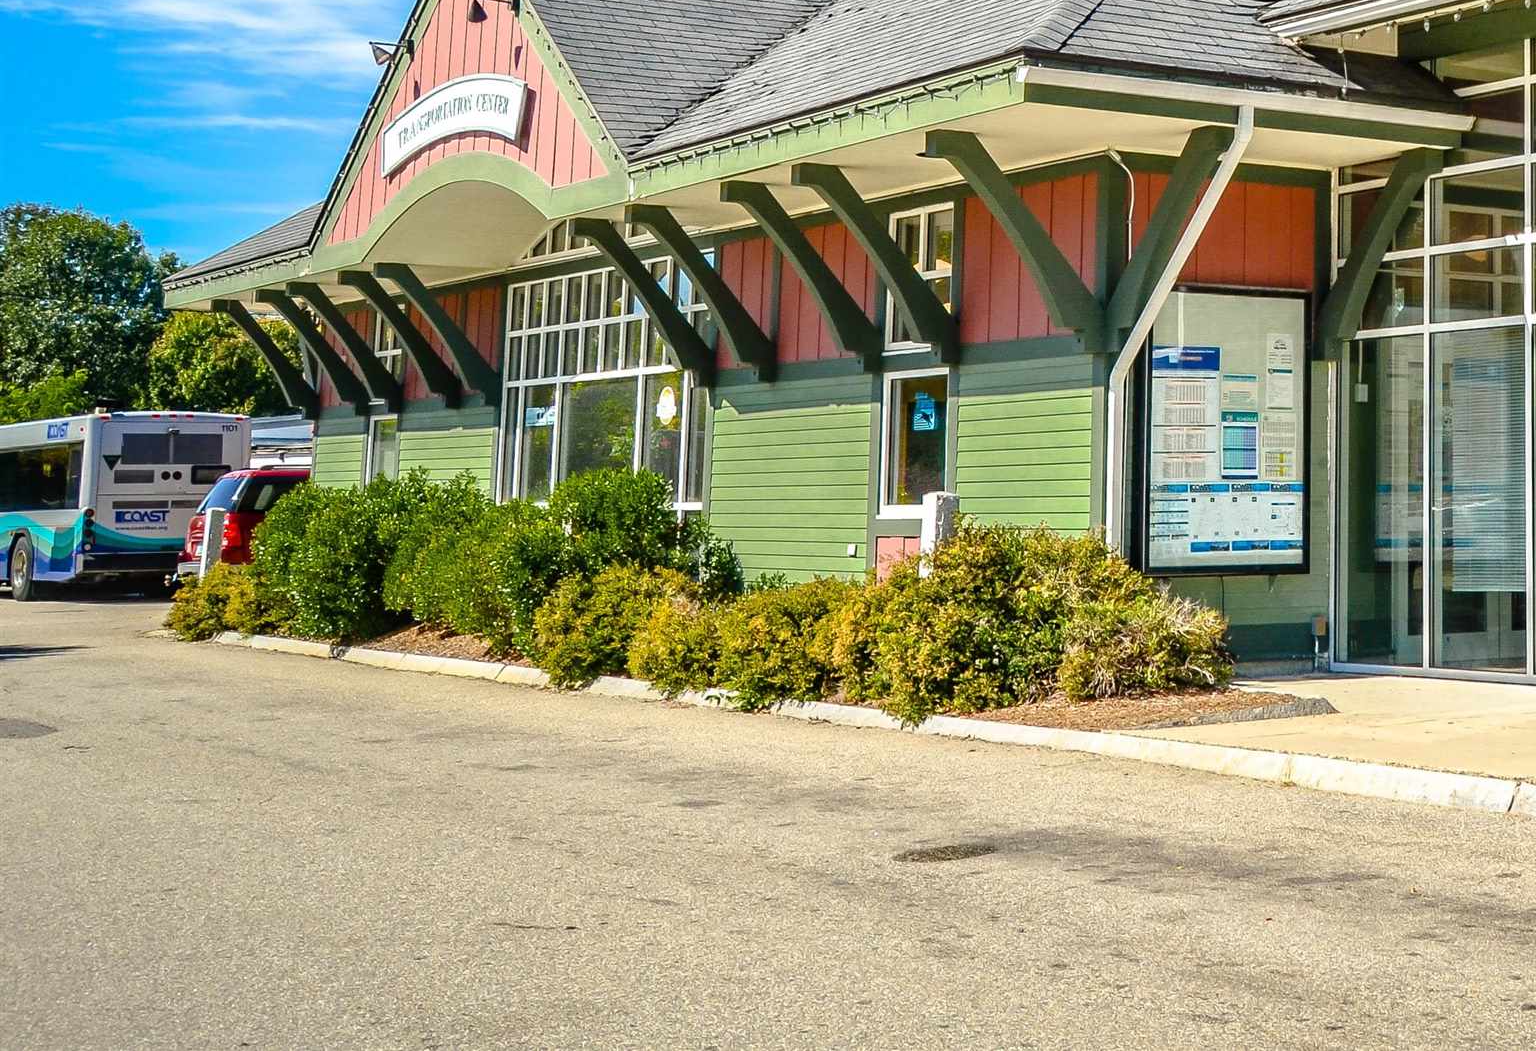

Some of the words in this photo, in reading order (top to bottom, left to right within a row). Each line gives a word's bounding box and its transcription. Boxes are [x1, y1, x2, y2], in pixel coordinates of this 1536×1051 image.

[398, 93, 473, 148] TRANSPORTATION
[476, 93, 510, 116] CENTER
[118, 510, 170, 522] COAST
